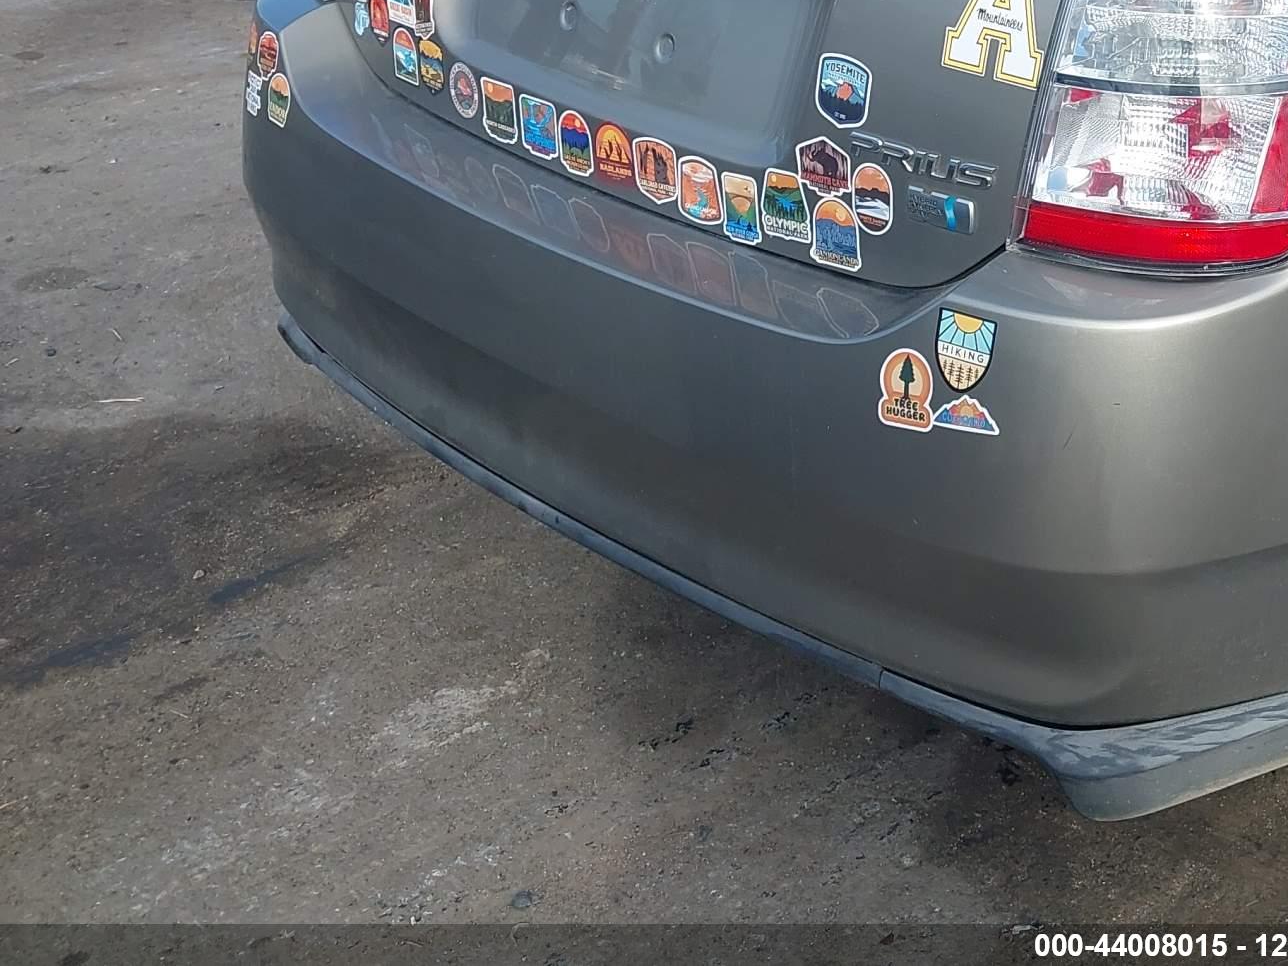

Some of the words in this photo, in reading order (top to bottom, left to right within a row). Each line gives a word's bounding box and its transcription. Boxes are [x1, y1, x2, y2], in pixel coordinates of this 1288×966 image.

[977, 8, 1023, 32] Mountaineers
[826, 63, 866, 84] YOSEMITE
[600, 163, 632, 177] BADLANDS
[850, 132, 998, 189] PRIUS
[765, 215, 808, 234] OLYMPIC
[942, 344, 984, 363] HIKING
[886, 406, 926, 422] HUGGER
[894, 399, 918, 410] TREE
